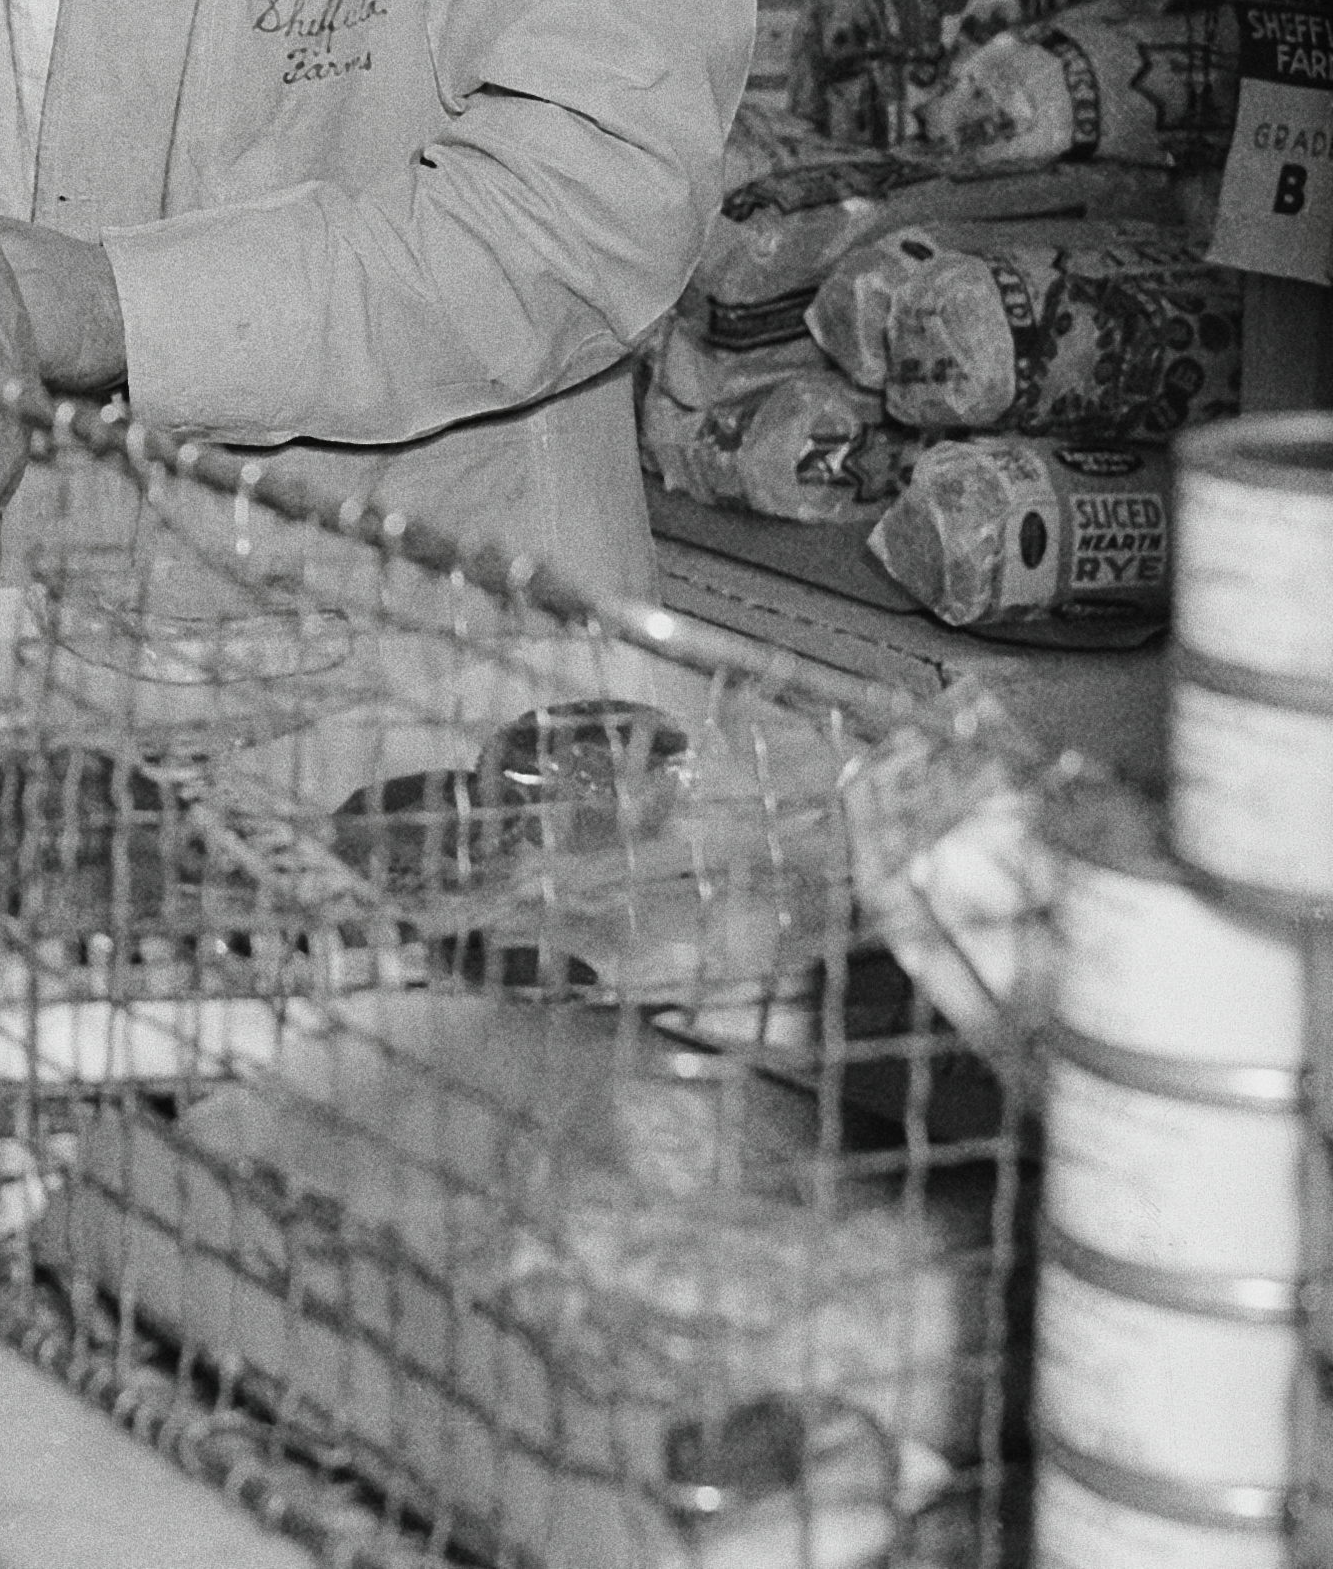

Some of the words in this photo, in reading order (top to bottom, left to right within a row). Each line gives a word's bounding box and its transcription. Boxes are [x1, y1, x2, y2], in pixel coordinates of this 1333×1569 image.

[1273, 163, 1308, 216] B
[1074, 497, 1163, 531] SLICED
[1075, 554, 1165, 582] RYE
